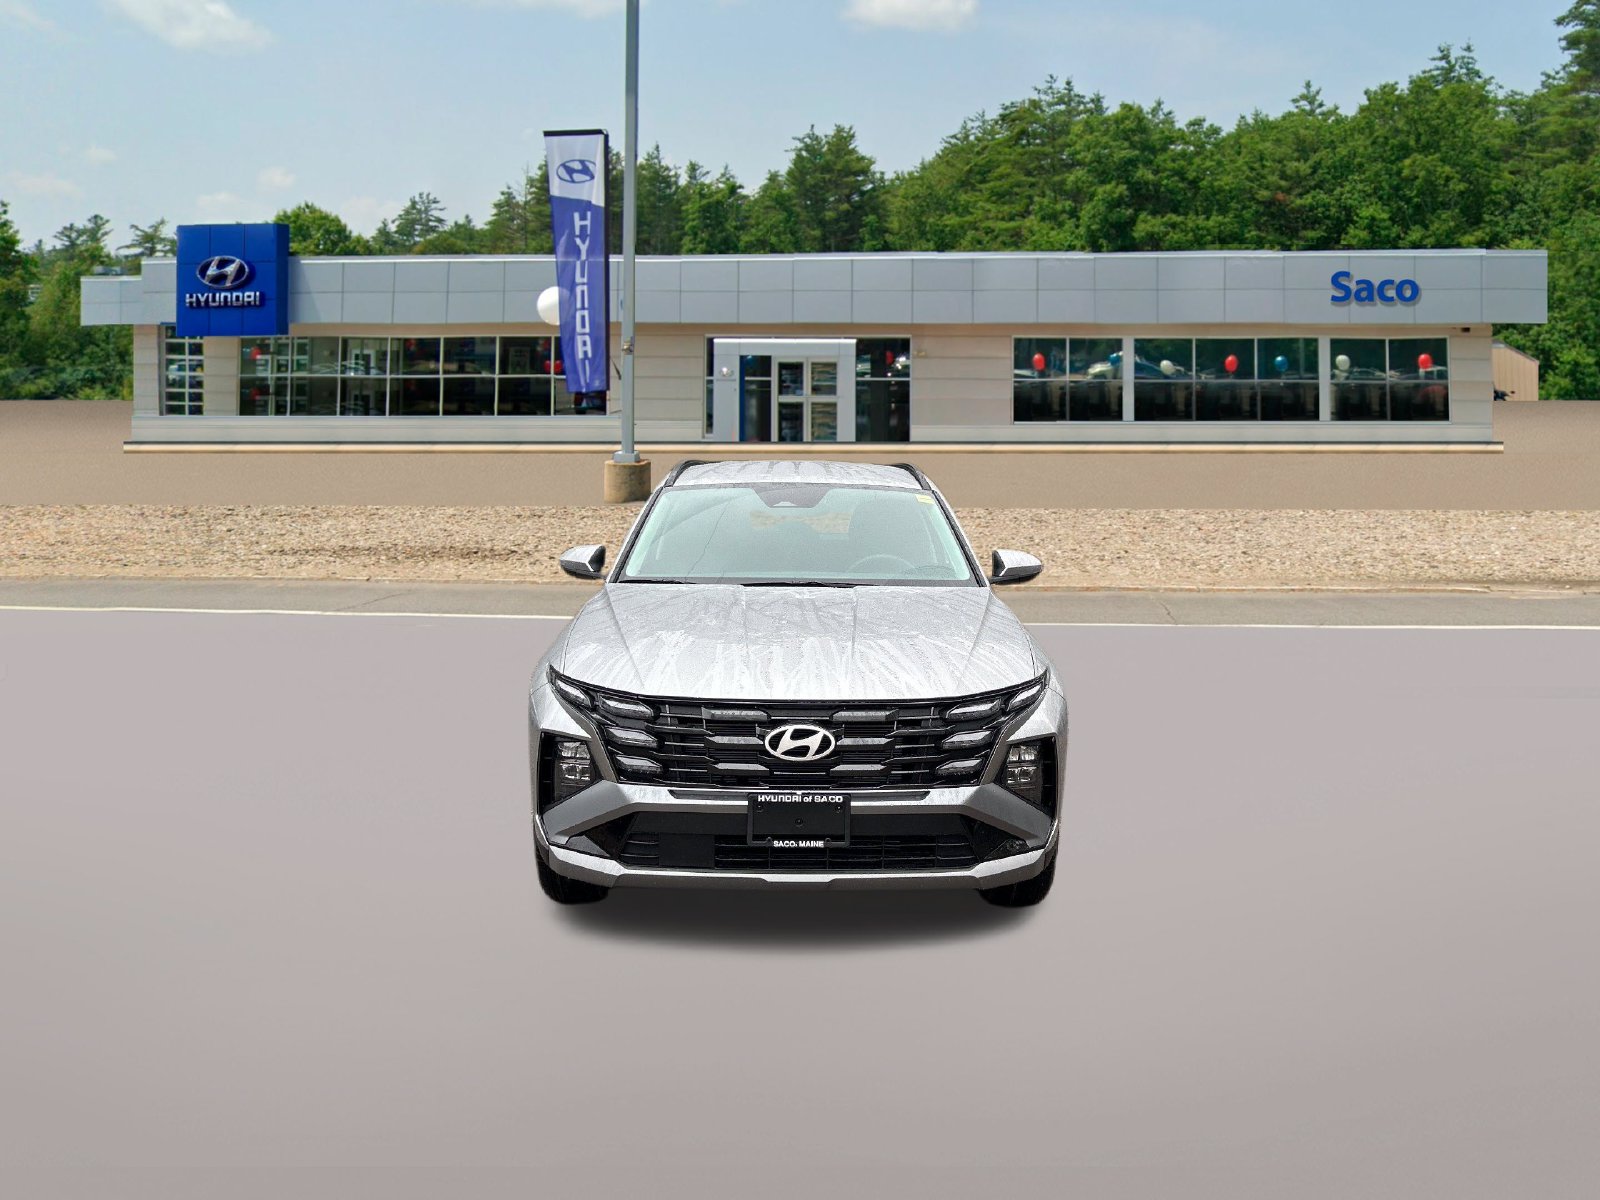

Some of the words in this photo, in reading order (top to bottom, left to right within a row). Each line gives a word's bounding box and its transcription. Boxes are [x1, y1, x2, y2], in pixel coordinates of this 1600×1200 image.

[1330, 270, 1420, 303] Saco
[185, 291, 260, 307] HYUNDAI
[573, 211, 592, 384] HYUNDAI
[758, 795, 802, 803] HYUNDAI
[803, 795, 813, 803] of
[814, 795, 843, 803] SACO
[798, 840, 824, 848] MAINE
